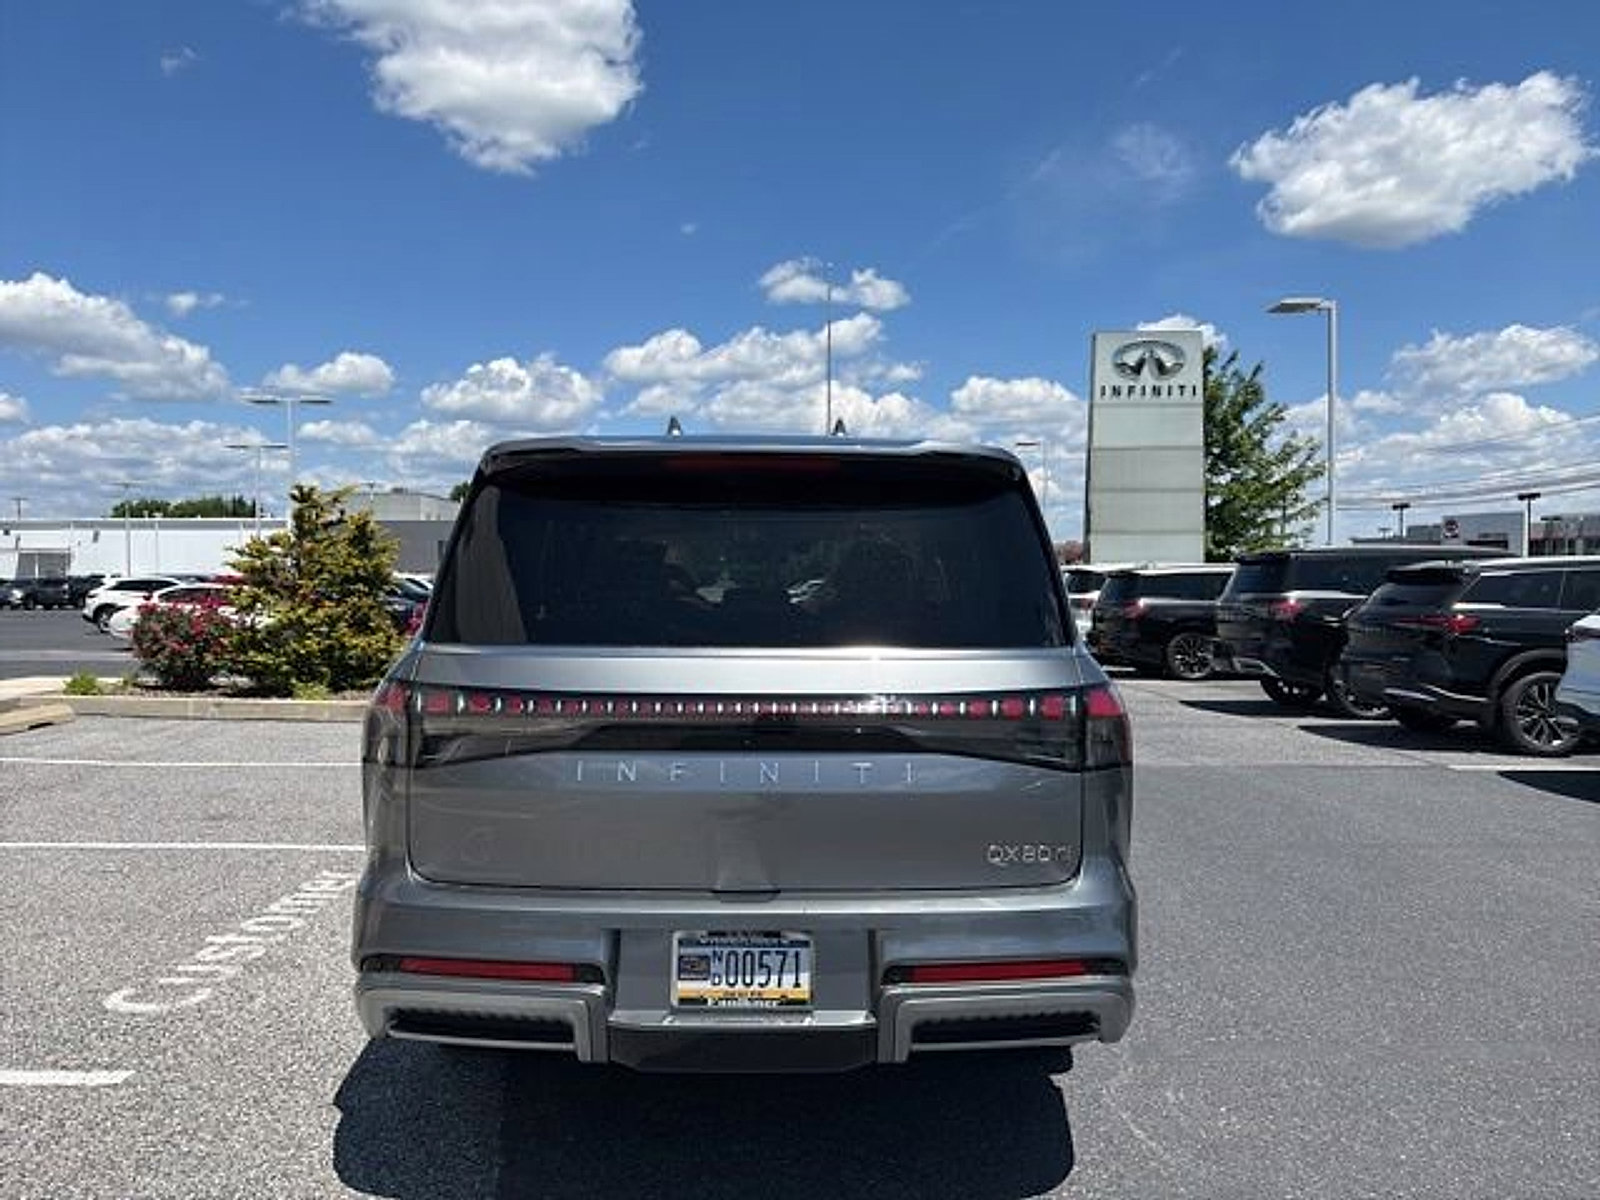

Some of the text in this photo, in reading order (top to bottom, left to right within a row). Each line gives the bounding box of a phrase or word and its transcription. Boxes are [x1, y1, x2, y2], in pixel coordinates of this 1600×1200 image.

[1100, 384, 1197, 398] INFINITI
[576, 760, 914, 784] INFINITI
[987, 844, 1052, 866] QX80
[725, 950, 802, 988] 00571
